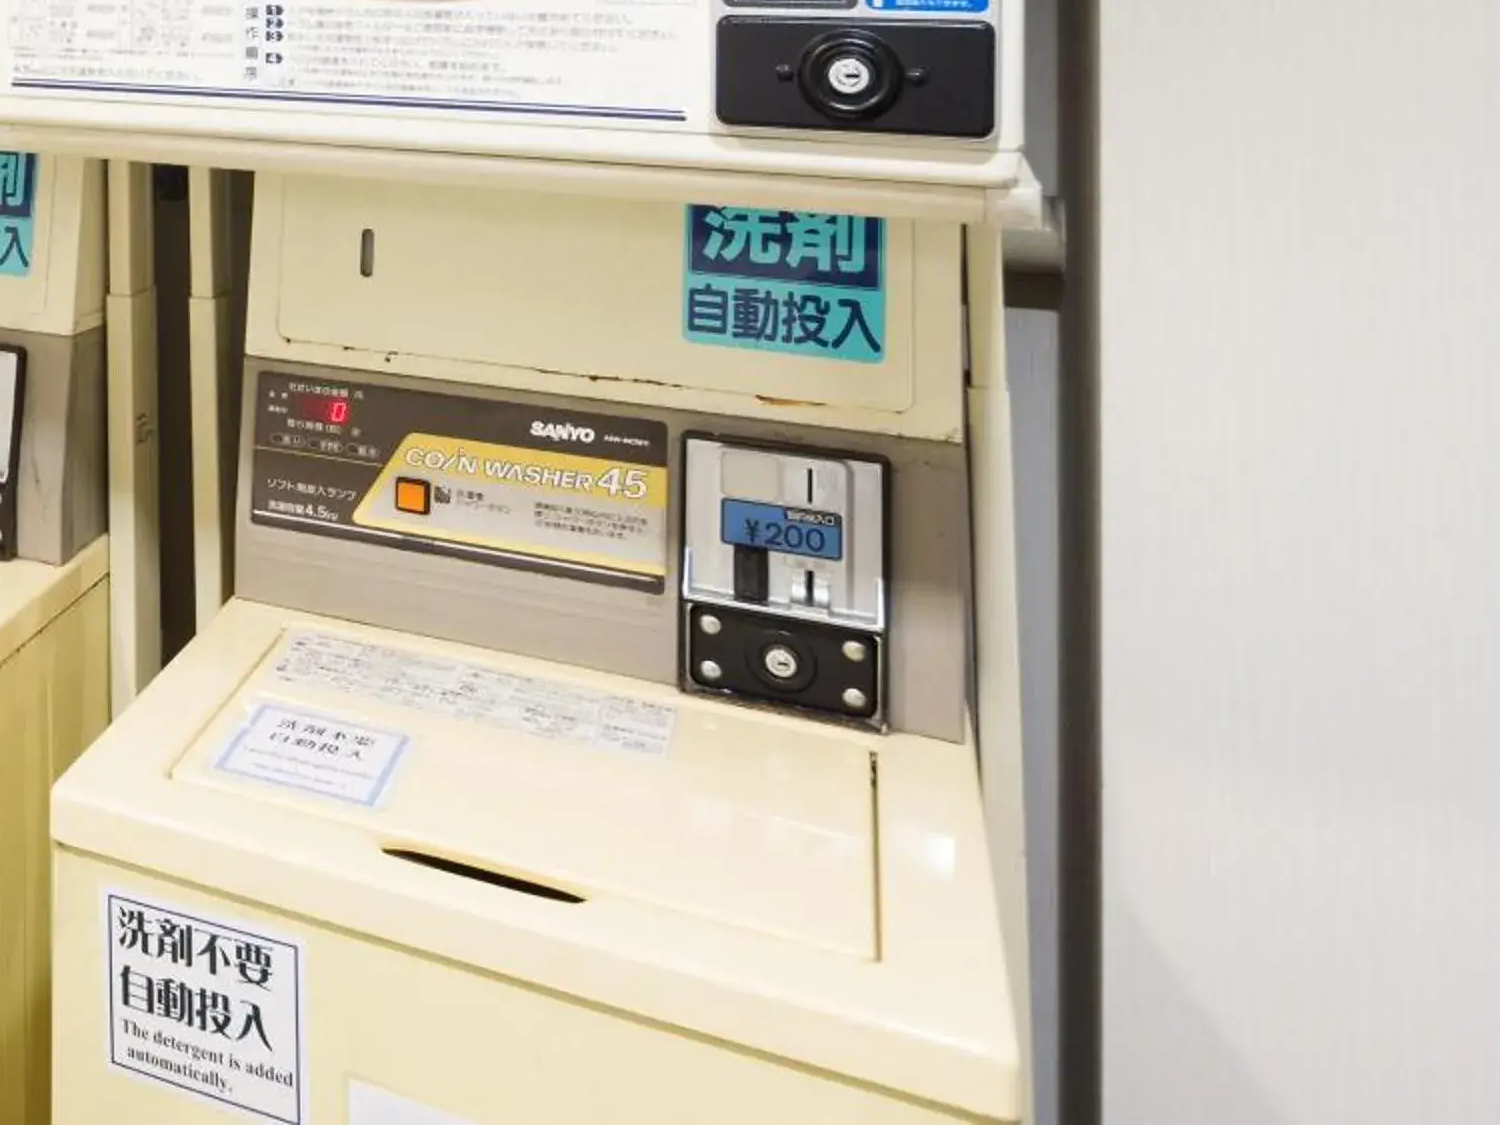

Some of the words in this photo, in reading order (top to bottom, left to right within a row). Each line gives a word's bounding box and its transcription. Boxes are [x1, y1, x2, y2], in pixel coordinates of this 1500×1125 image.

[702, 207, 866, 273] 洗剤
[688, 283, 881, 353] 自動投入
[331, 402, 347, 422] 0
[530, 420, 596, 444] SANYO
[404, 447, 478, 475] COIN
[485, 459, 593, 492] WASHER
[597, 466, 650, 499] 45
[744, 518, 826, 553] ¥200
[118, 906, 275, 992] 洗剤不要
[119, 965, 274, 1053] 自動投入
[122, 1018, 149, 1041] The
[153, 1030, 225, 1067] detergent
[229, 1052, 241, 1071] is
[245, 1062, 294, 1088] added
[127, 1046, 233, 1094] automatically.
